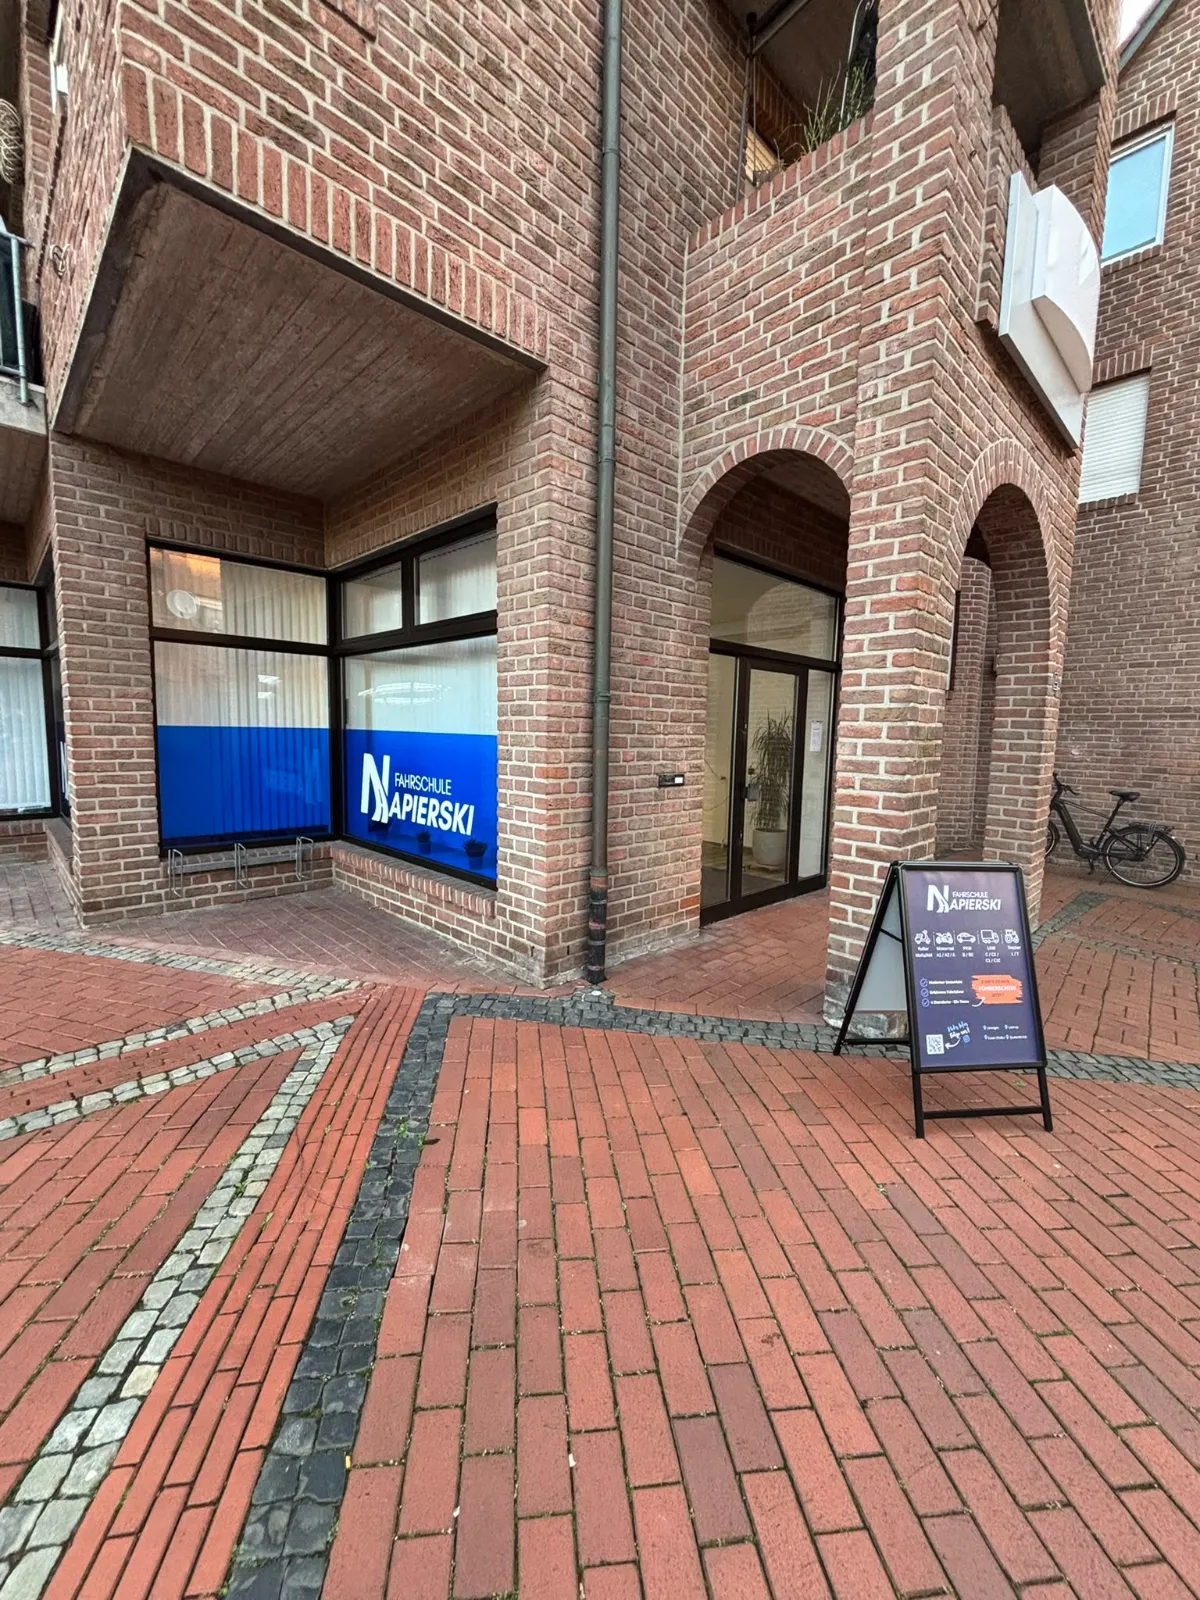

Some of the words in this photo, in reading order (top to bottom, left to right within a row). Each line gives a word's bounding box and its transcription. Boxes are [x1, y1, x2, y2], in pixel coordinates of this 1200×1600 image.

[360, 752, 475, 836] NAPIERSKI
[394, 772, 452, 796] FAHRSCHULE
[926, 884, 1002, 914] NAPIERSKI
[952, 891, 989, 899] FAHRSCHULE
